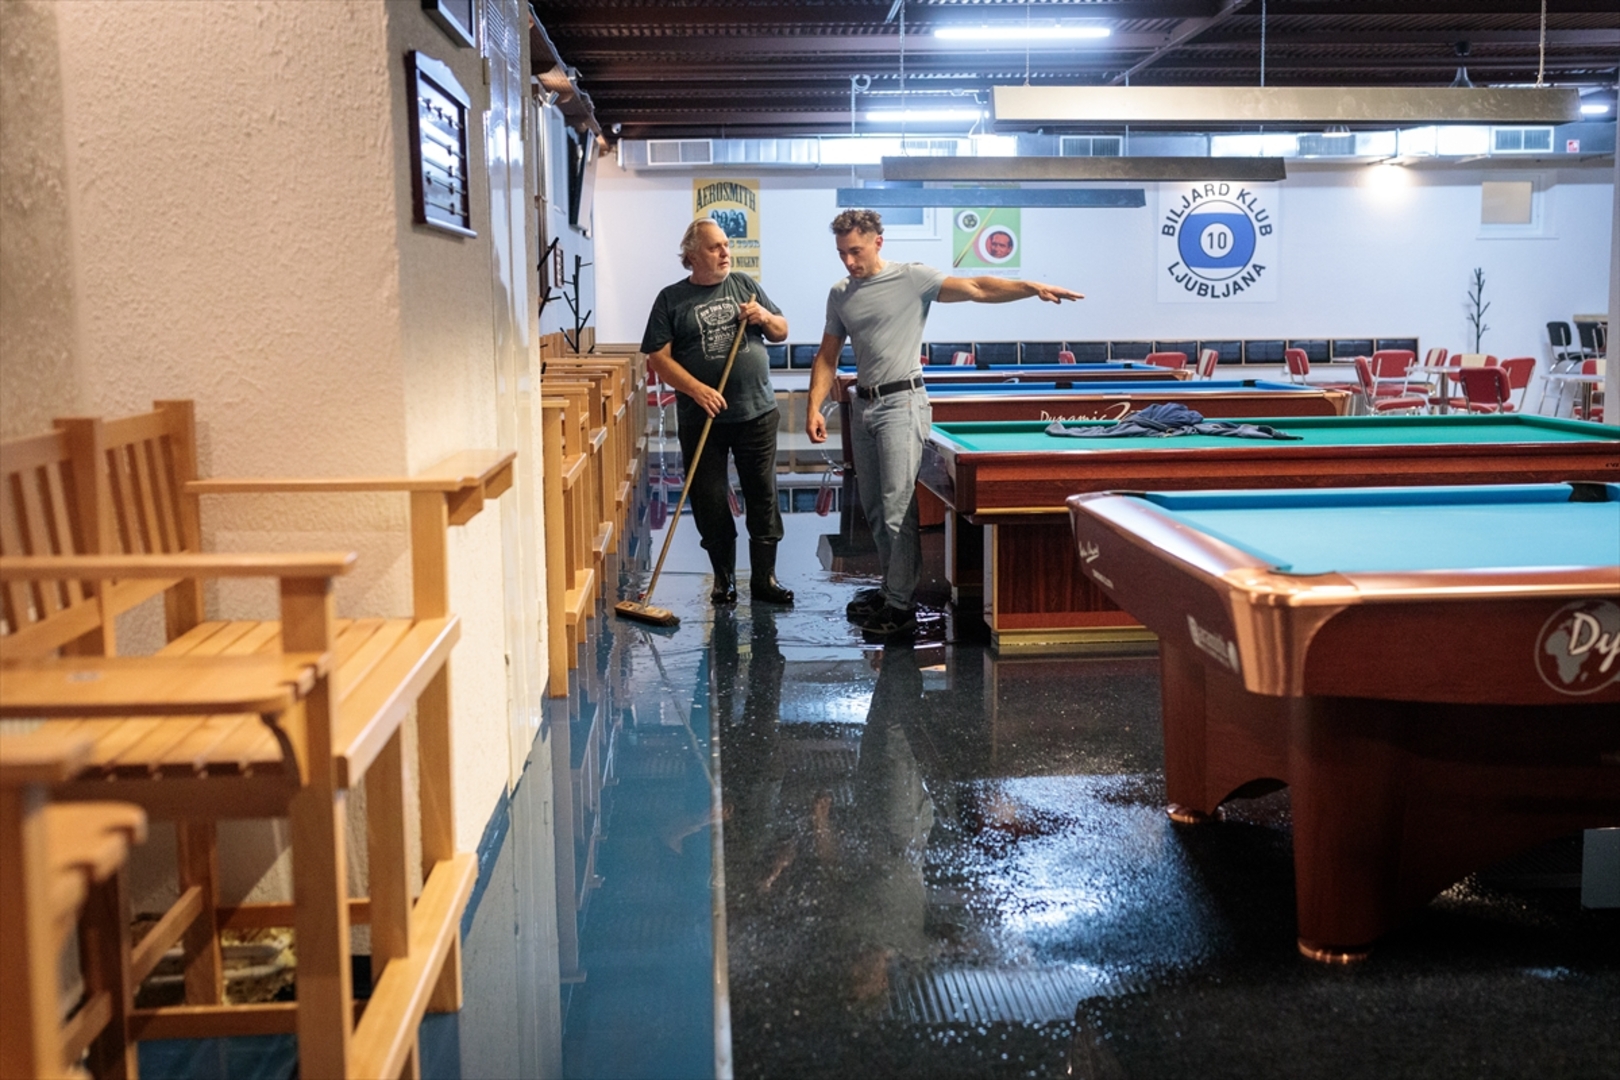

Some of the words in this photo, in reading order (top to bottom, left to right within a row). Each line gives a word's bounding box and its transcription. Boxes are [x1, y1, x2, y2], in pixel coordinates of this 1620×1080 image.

[696, 182, 756, 213] AEROSMITH
[1161, 183, 1230, 237] BILJARD
[1236, 188, 1273, 237] KLUB
[1207, 232, 1227, 250] 10
[736, 256, 759, 268] NUGENT
[1167, 261, 1266, 299] LJUBLJANA
